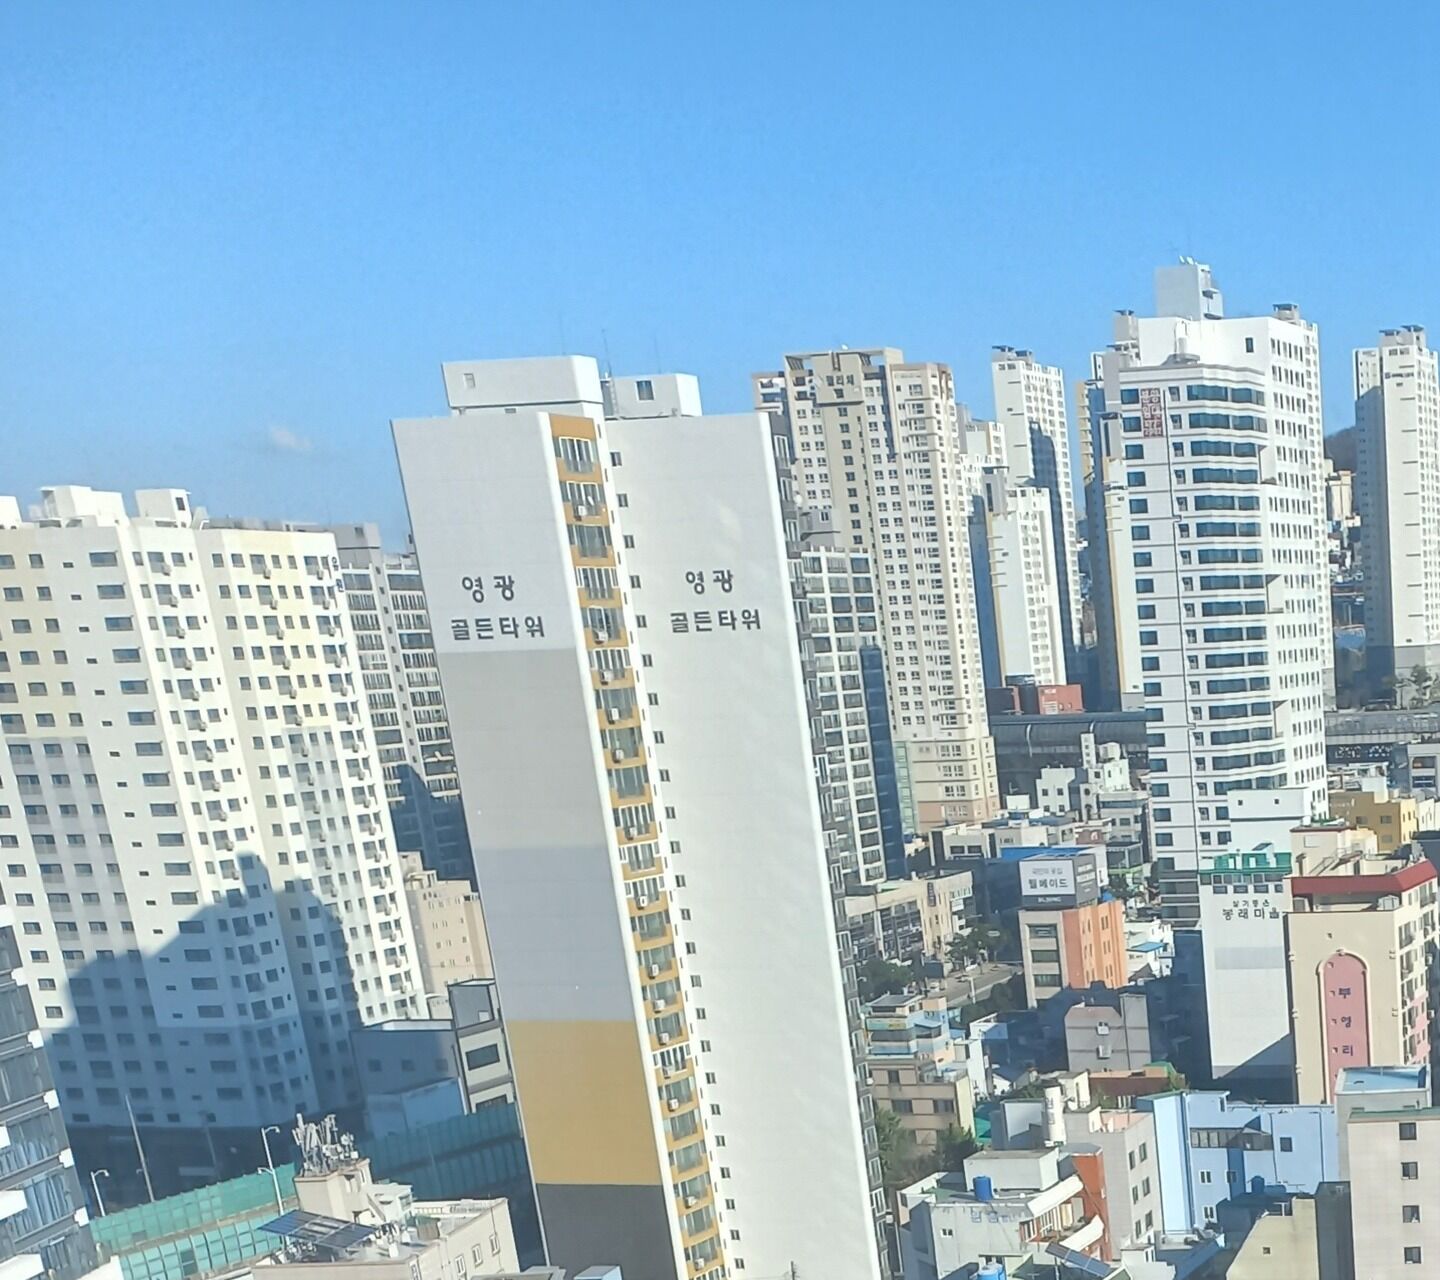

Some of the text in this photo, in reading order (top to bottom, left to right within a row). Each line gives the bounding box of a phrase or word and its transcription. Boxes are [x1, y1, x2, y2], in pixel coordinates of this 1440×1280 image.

[461, 575, 515, 603] 영광
[685, 569, 734, 595] 영광
[450, 615, 545, 641] 골든타워
[669, 608, 761, 634] 골든타워
